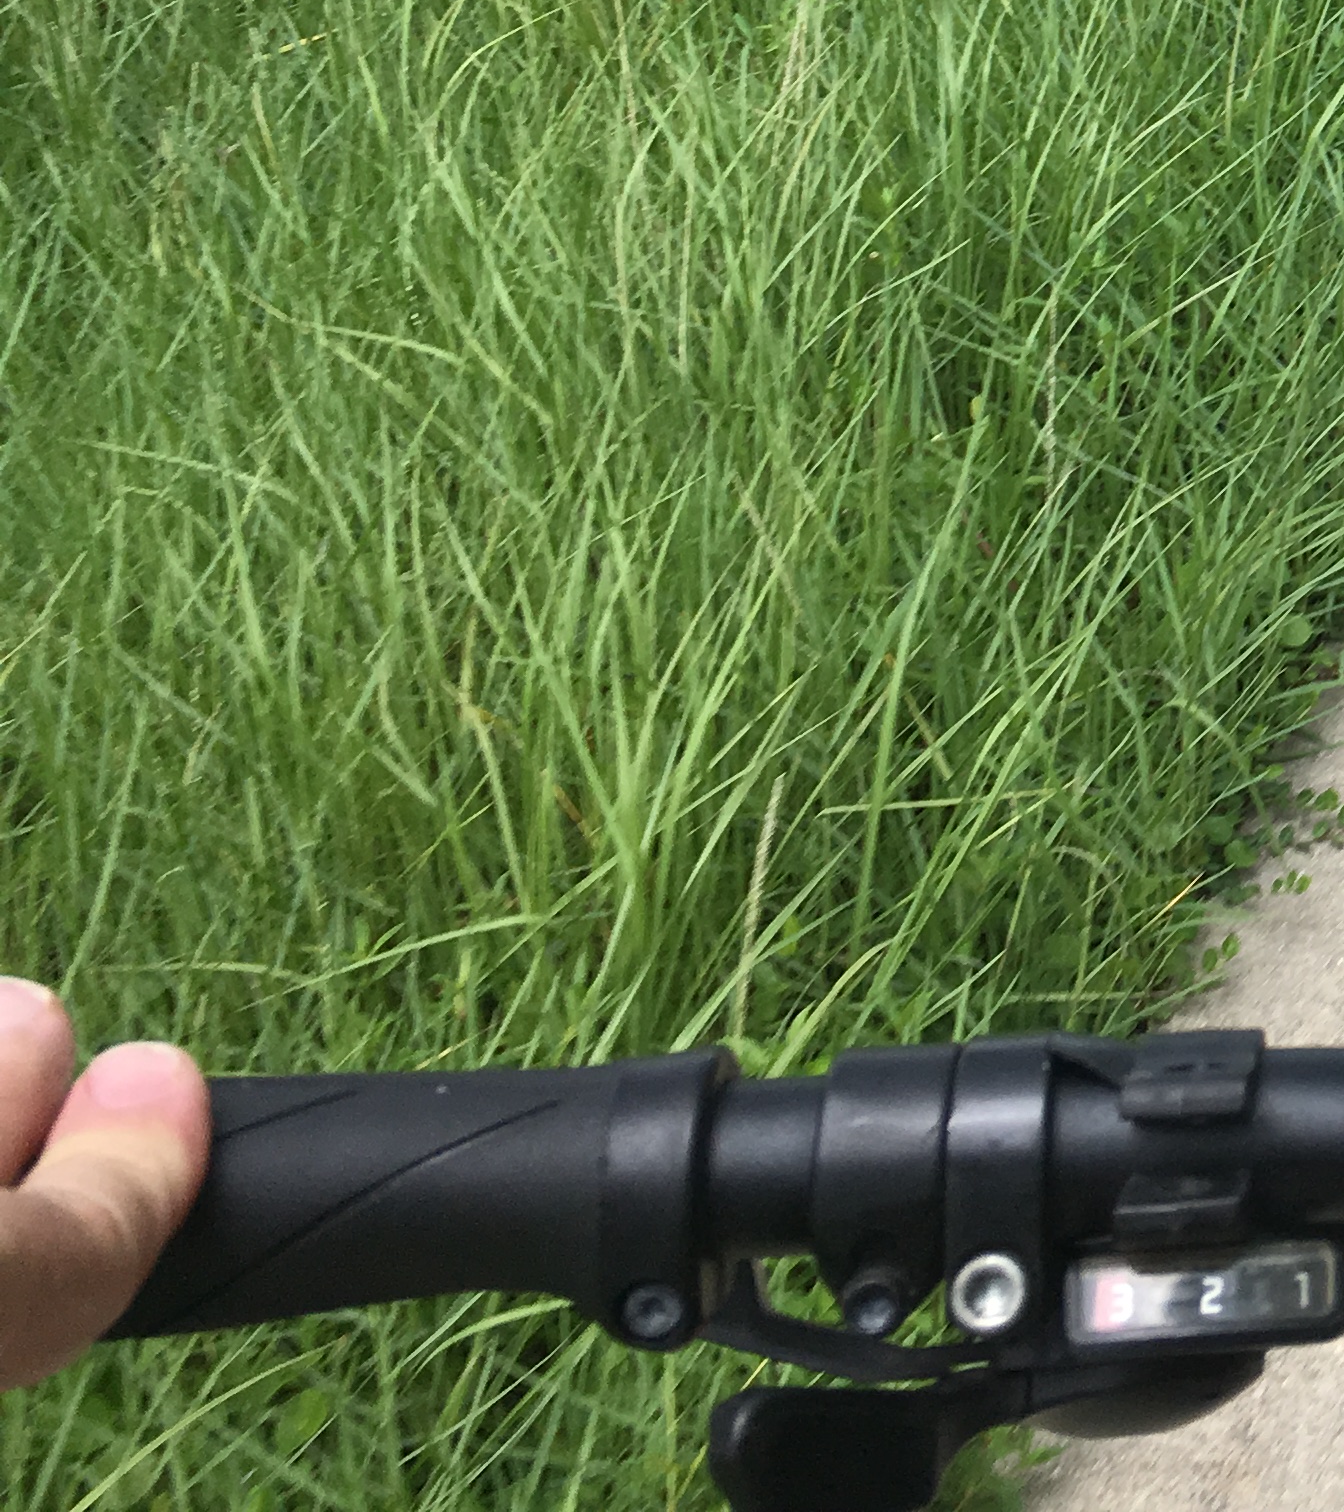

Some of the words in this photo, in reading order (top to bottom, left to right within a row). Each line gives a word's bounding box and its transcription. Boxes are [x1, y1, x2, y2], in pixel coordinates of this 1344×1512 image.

[1109, 1282, 1134, 1323] 3
[1199, 1275, 1225, 1315] 2
[1293, 1271, 1311, 1308] 1
